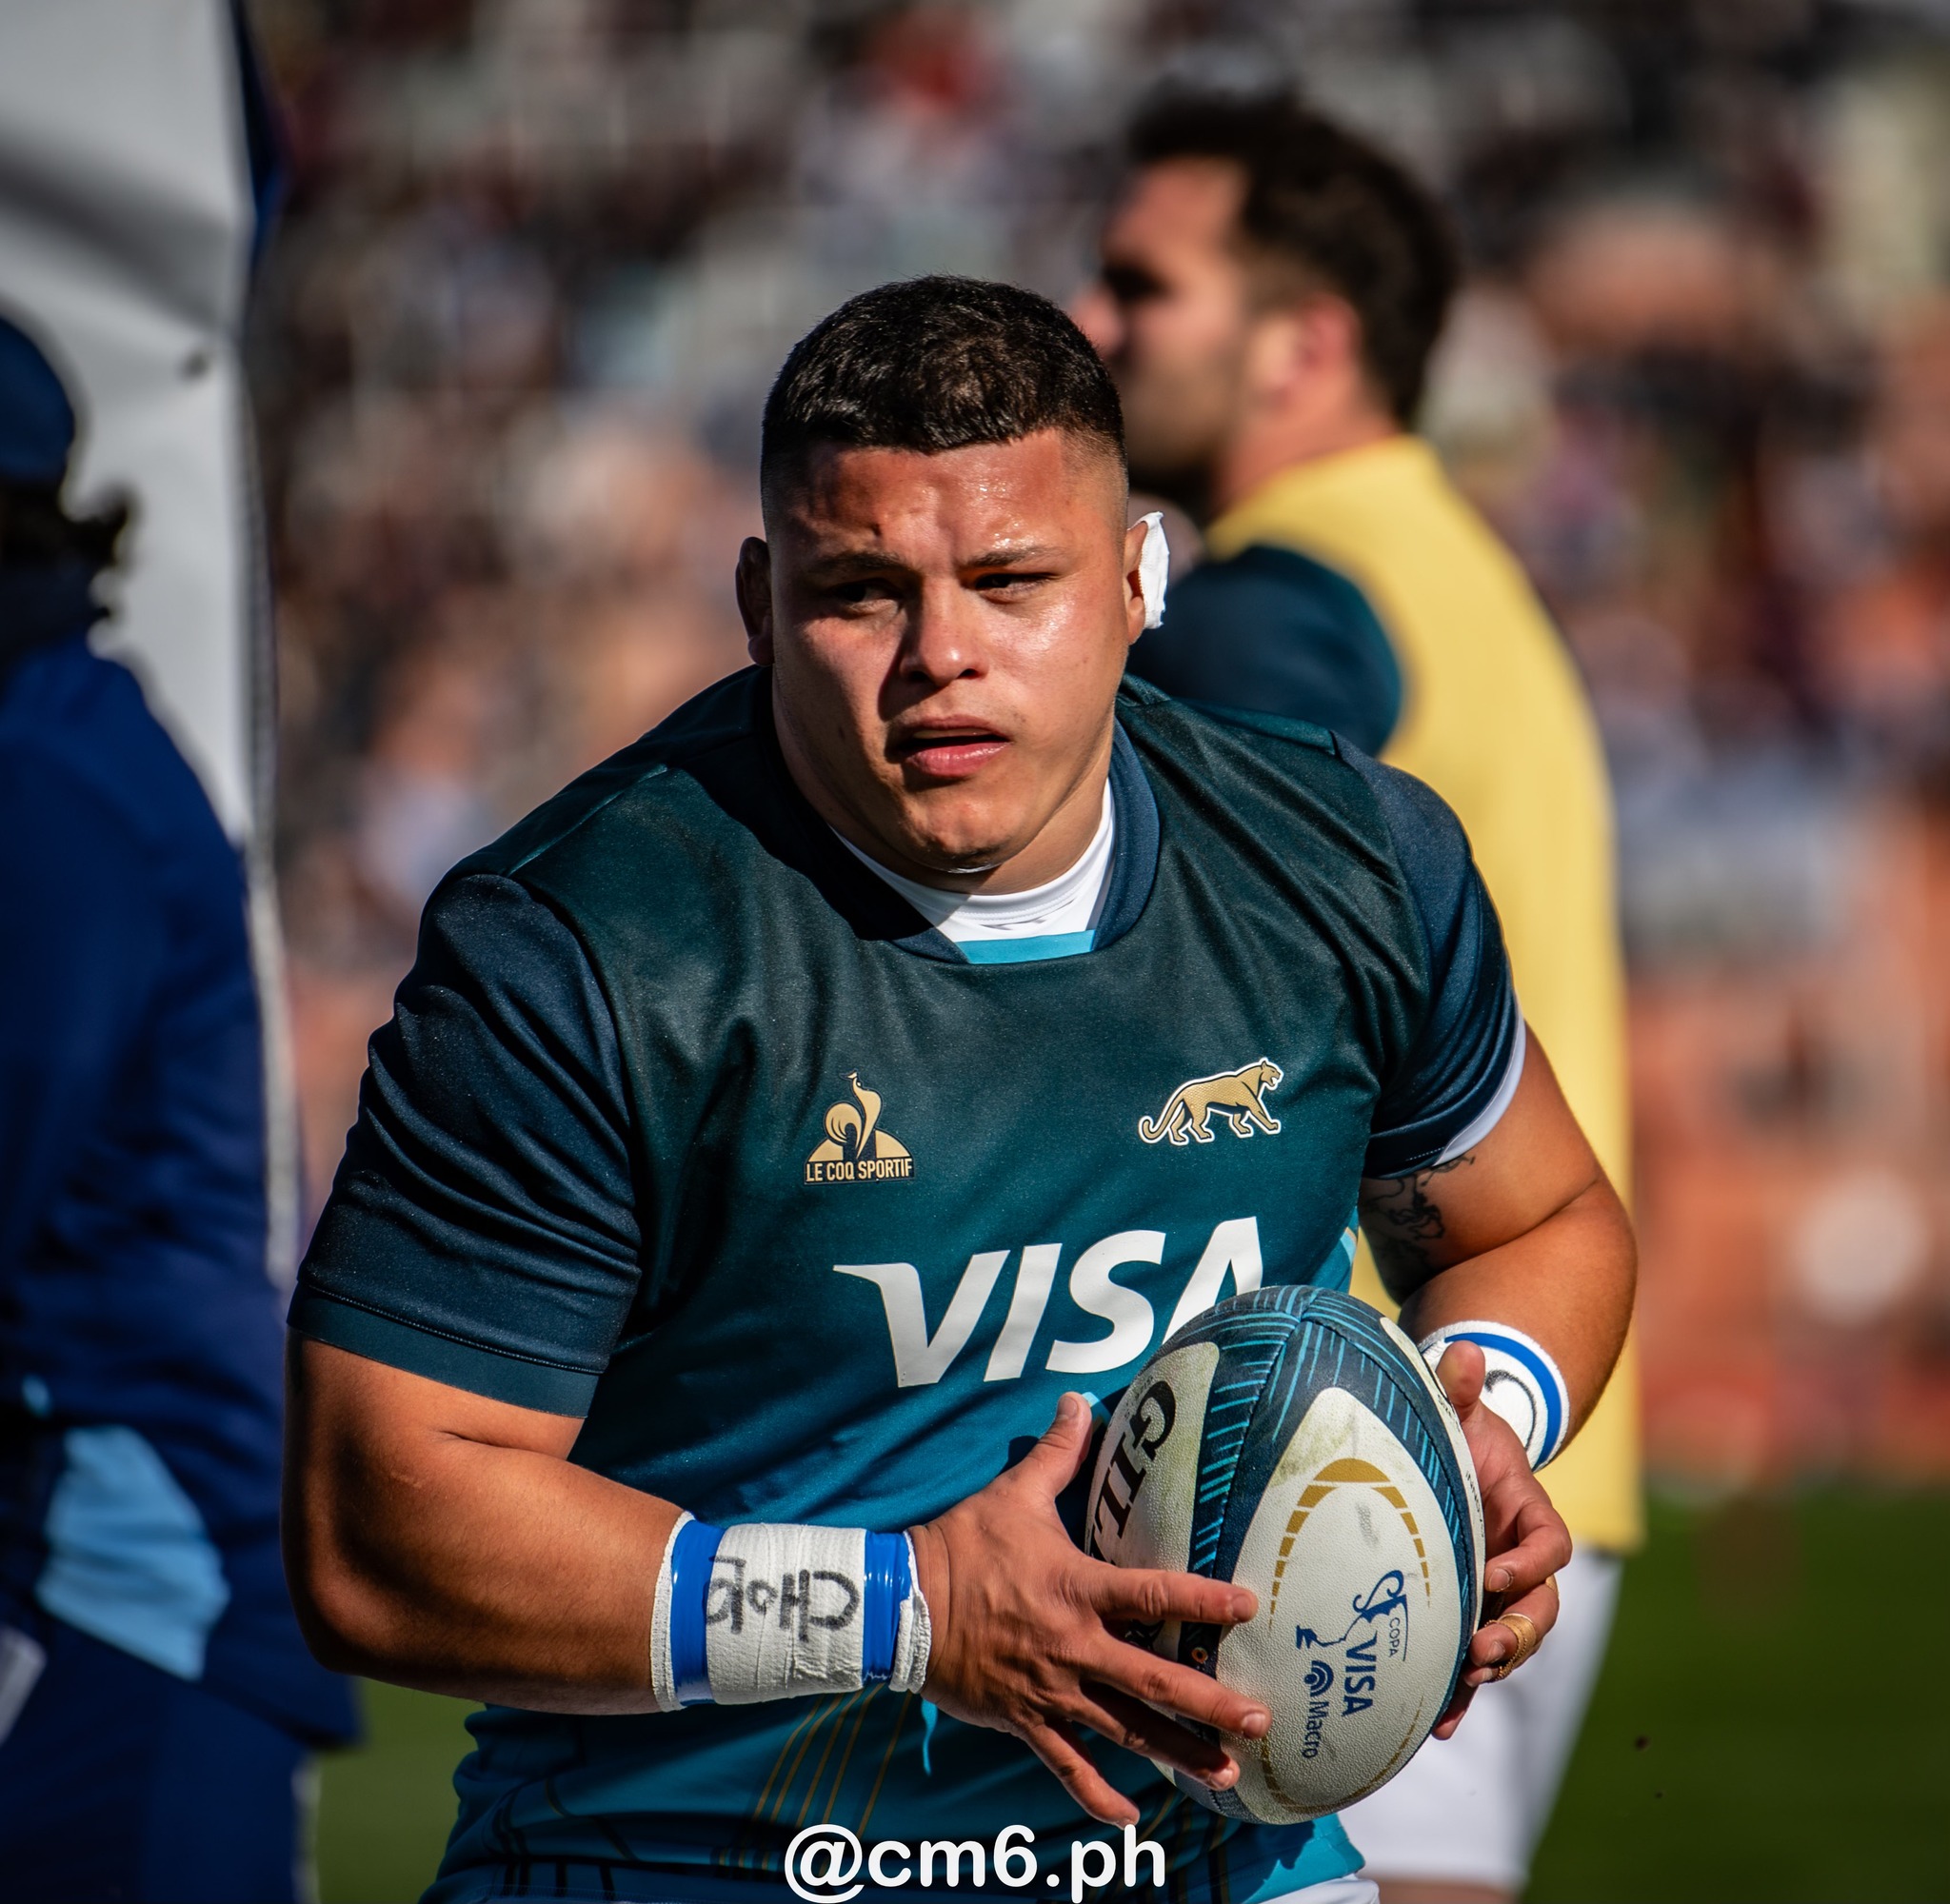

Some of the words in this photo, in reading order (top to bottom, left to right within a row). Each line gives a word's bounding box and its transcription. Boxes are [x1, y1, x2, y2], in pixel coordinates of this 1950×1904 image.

[806, 1163, 824, 1182] LE
[826, 1161, 855, 1181] COQ
[858, 1159, 912, 1179] SPORTIF
[833, 1216, 1264, 1388] VISA
[1090, 1380, 1176, 1566] GIL
[1341, 1629, 1378, 1717] VISA
[1388, 1616, 1401, 1658] COPA
[1301, 1700, 1330, 1759] Macro
